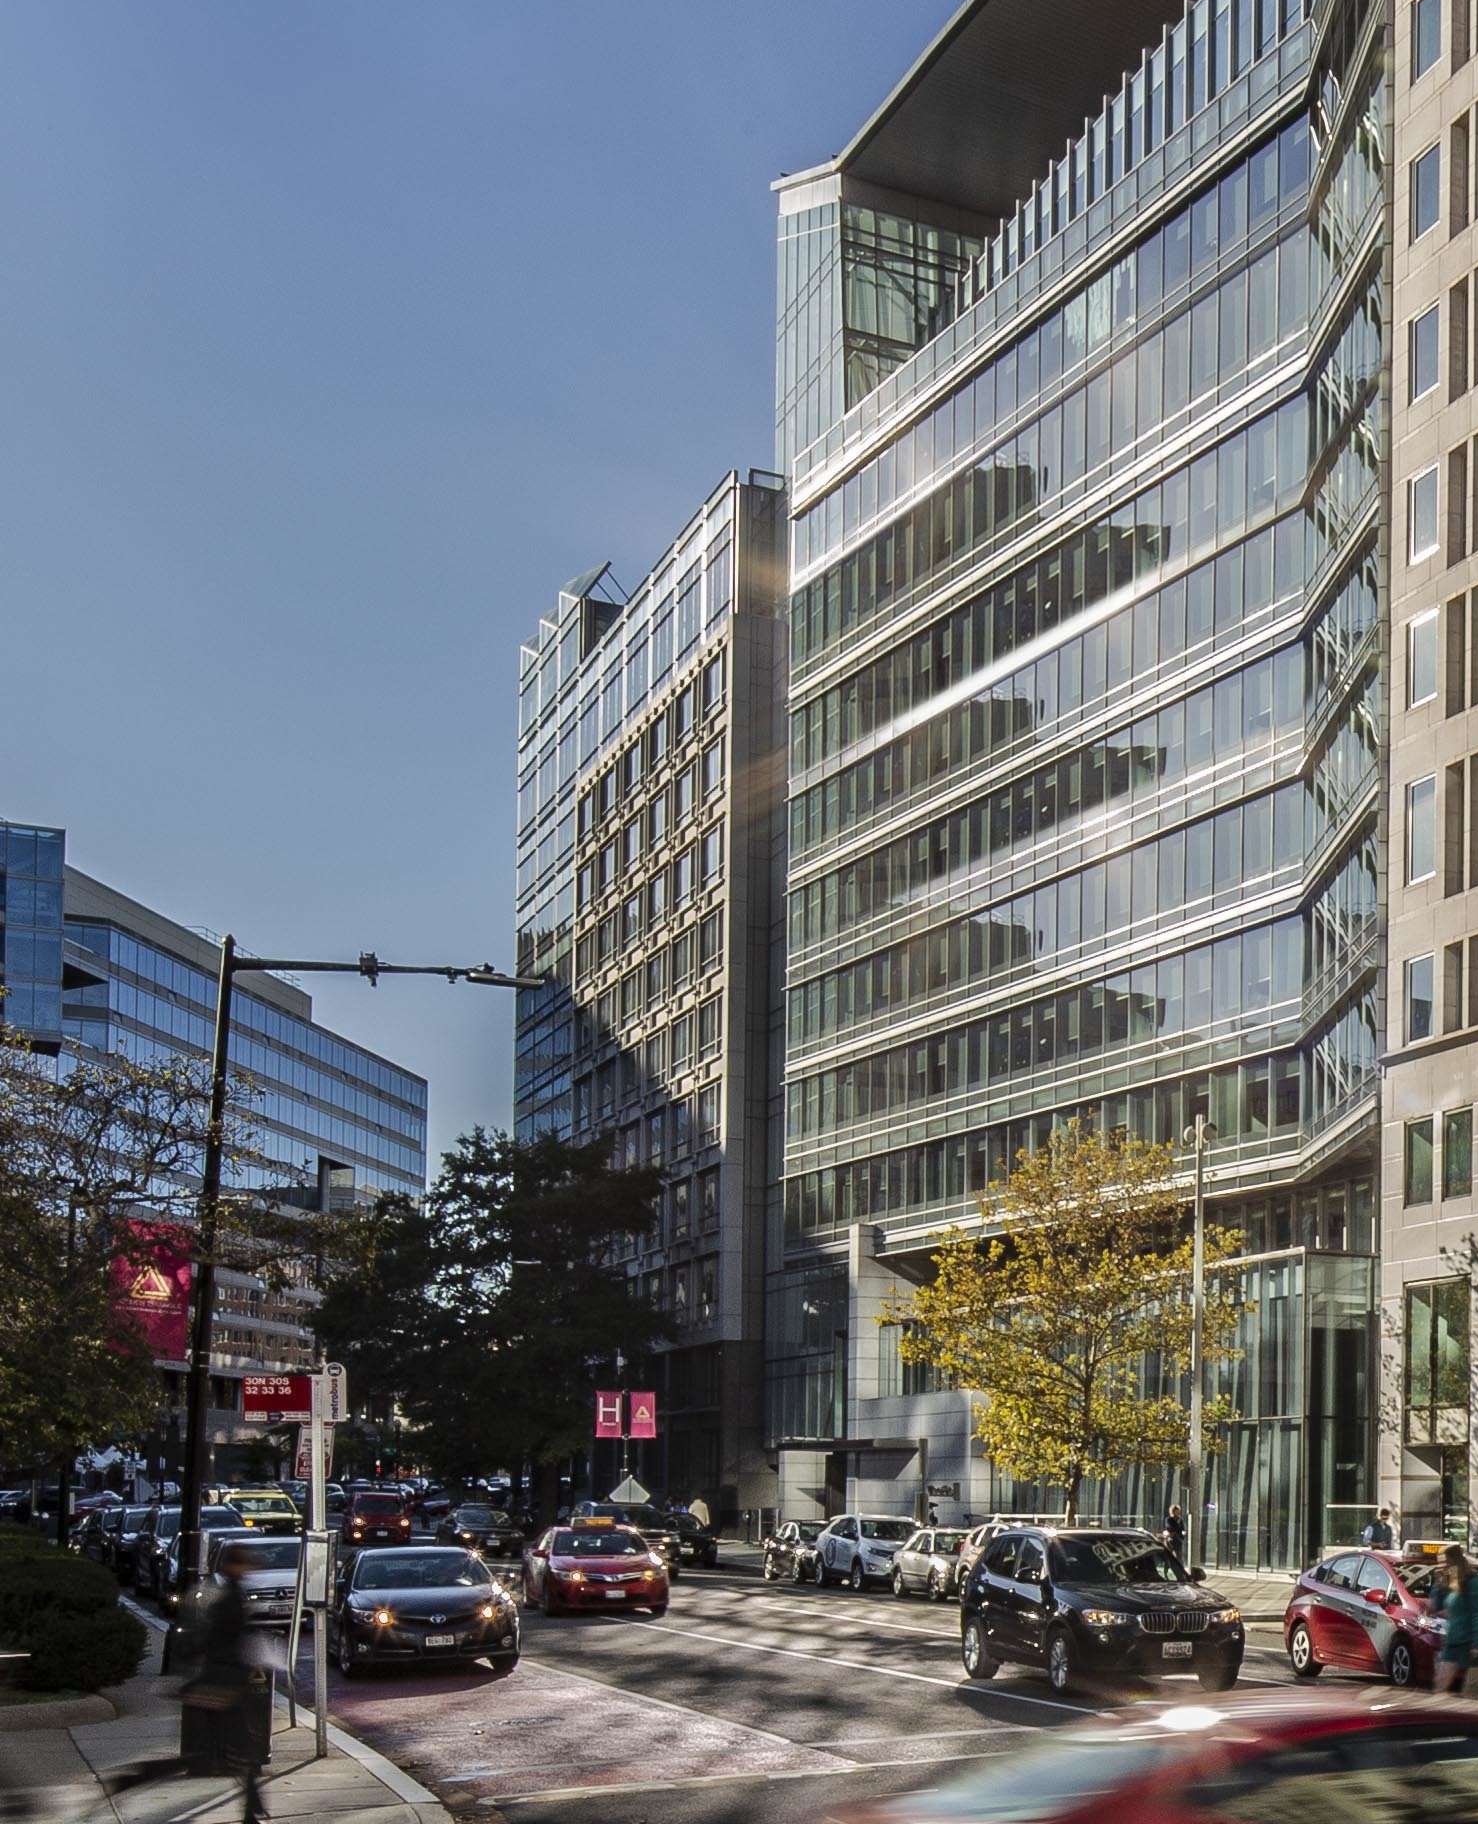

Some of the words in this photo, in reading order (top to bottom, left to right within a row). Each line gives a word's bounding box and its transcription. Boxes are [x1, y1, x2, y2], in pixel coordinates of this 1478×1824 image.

[245, 1377, 266, 1385] 30N
[269, 1377, 290, 1385] 30S
[245, 1386, 258, 1395] 32
[261, 1386, 275, 1395] 33
[278, 1386, 292, 1395] 36
[330, 1378, 339, 1420] metrobus
[599, 1396, 620, 1423] H
